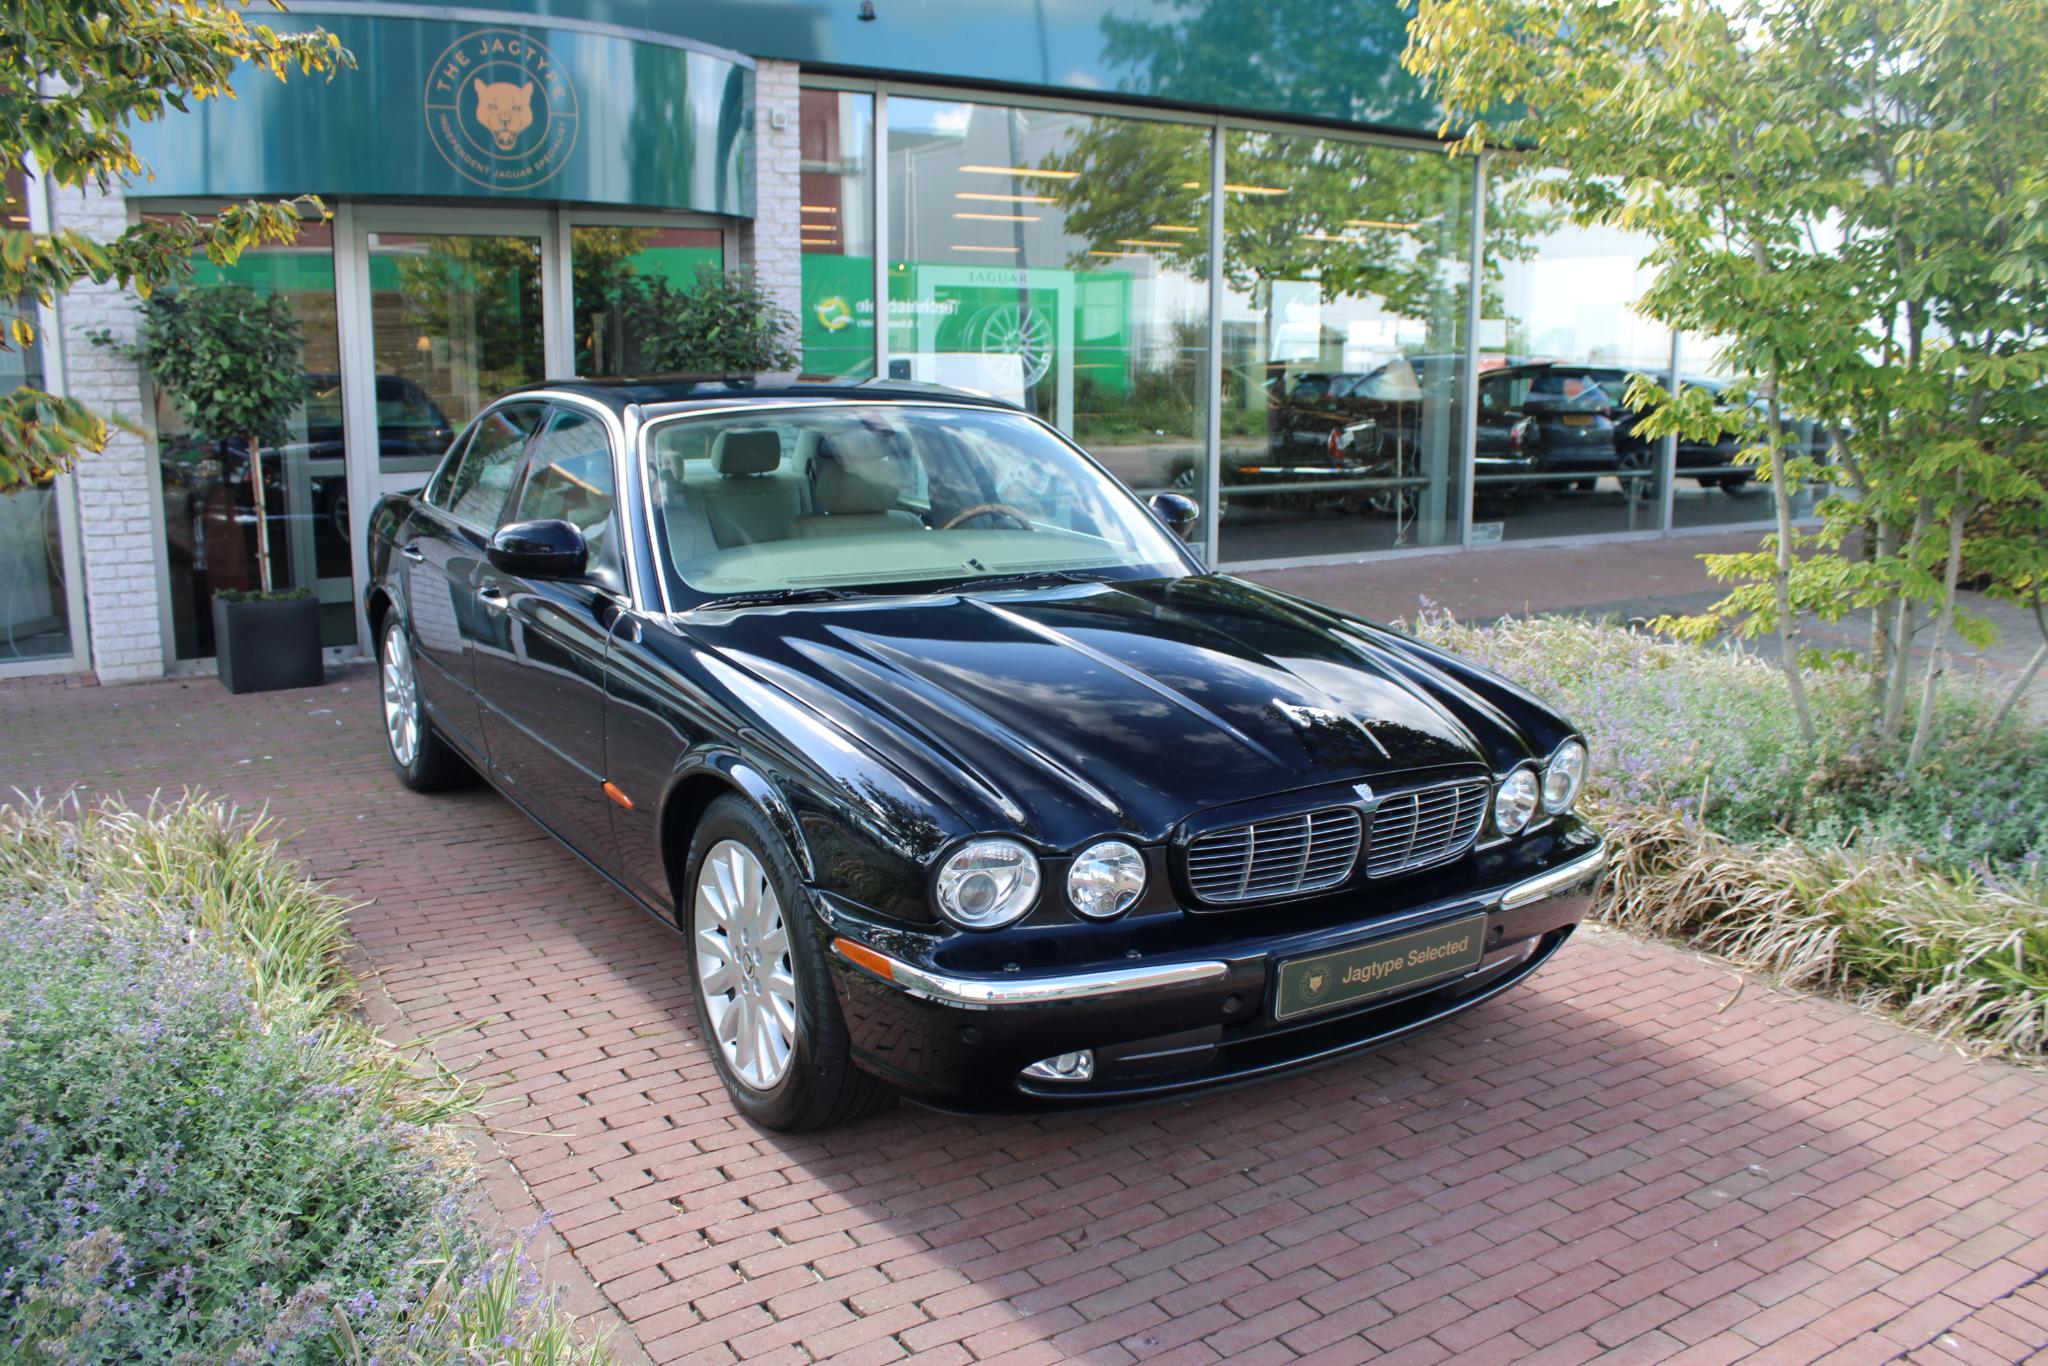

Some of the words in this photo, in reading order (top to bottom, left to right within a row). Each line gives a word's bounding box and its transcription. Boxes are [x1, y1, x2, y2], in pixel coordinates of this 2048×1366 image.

[437, 50, 470, 91] THE
[479, 38, 566, 97] JAGTYPE
[439, 113, 490, 174] INDEPENDENT
[494, 166, 533, 178] JAGUAR
[534, 121, 567, 171] SPECIALIST
[969, 271, 1027, 284] JAGUAR
[1342, 957, 1404, 984] Jagtype
[1407, 936, 1469, 967] Selected
